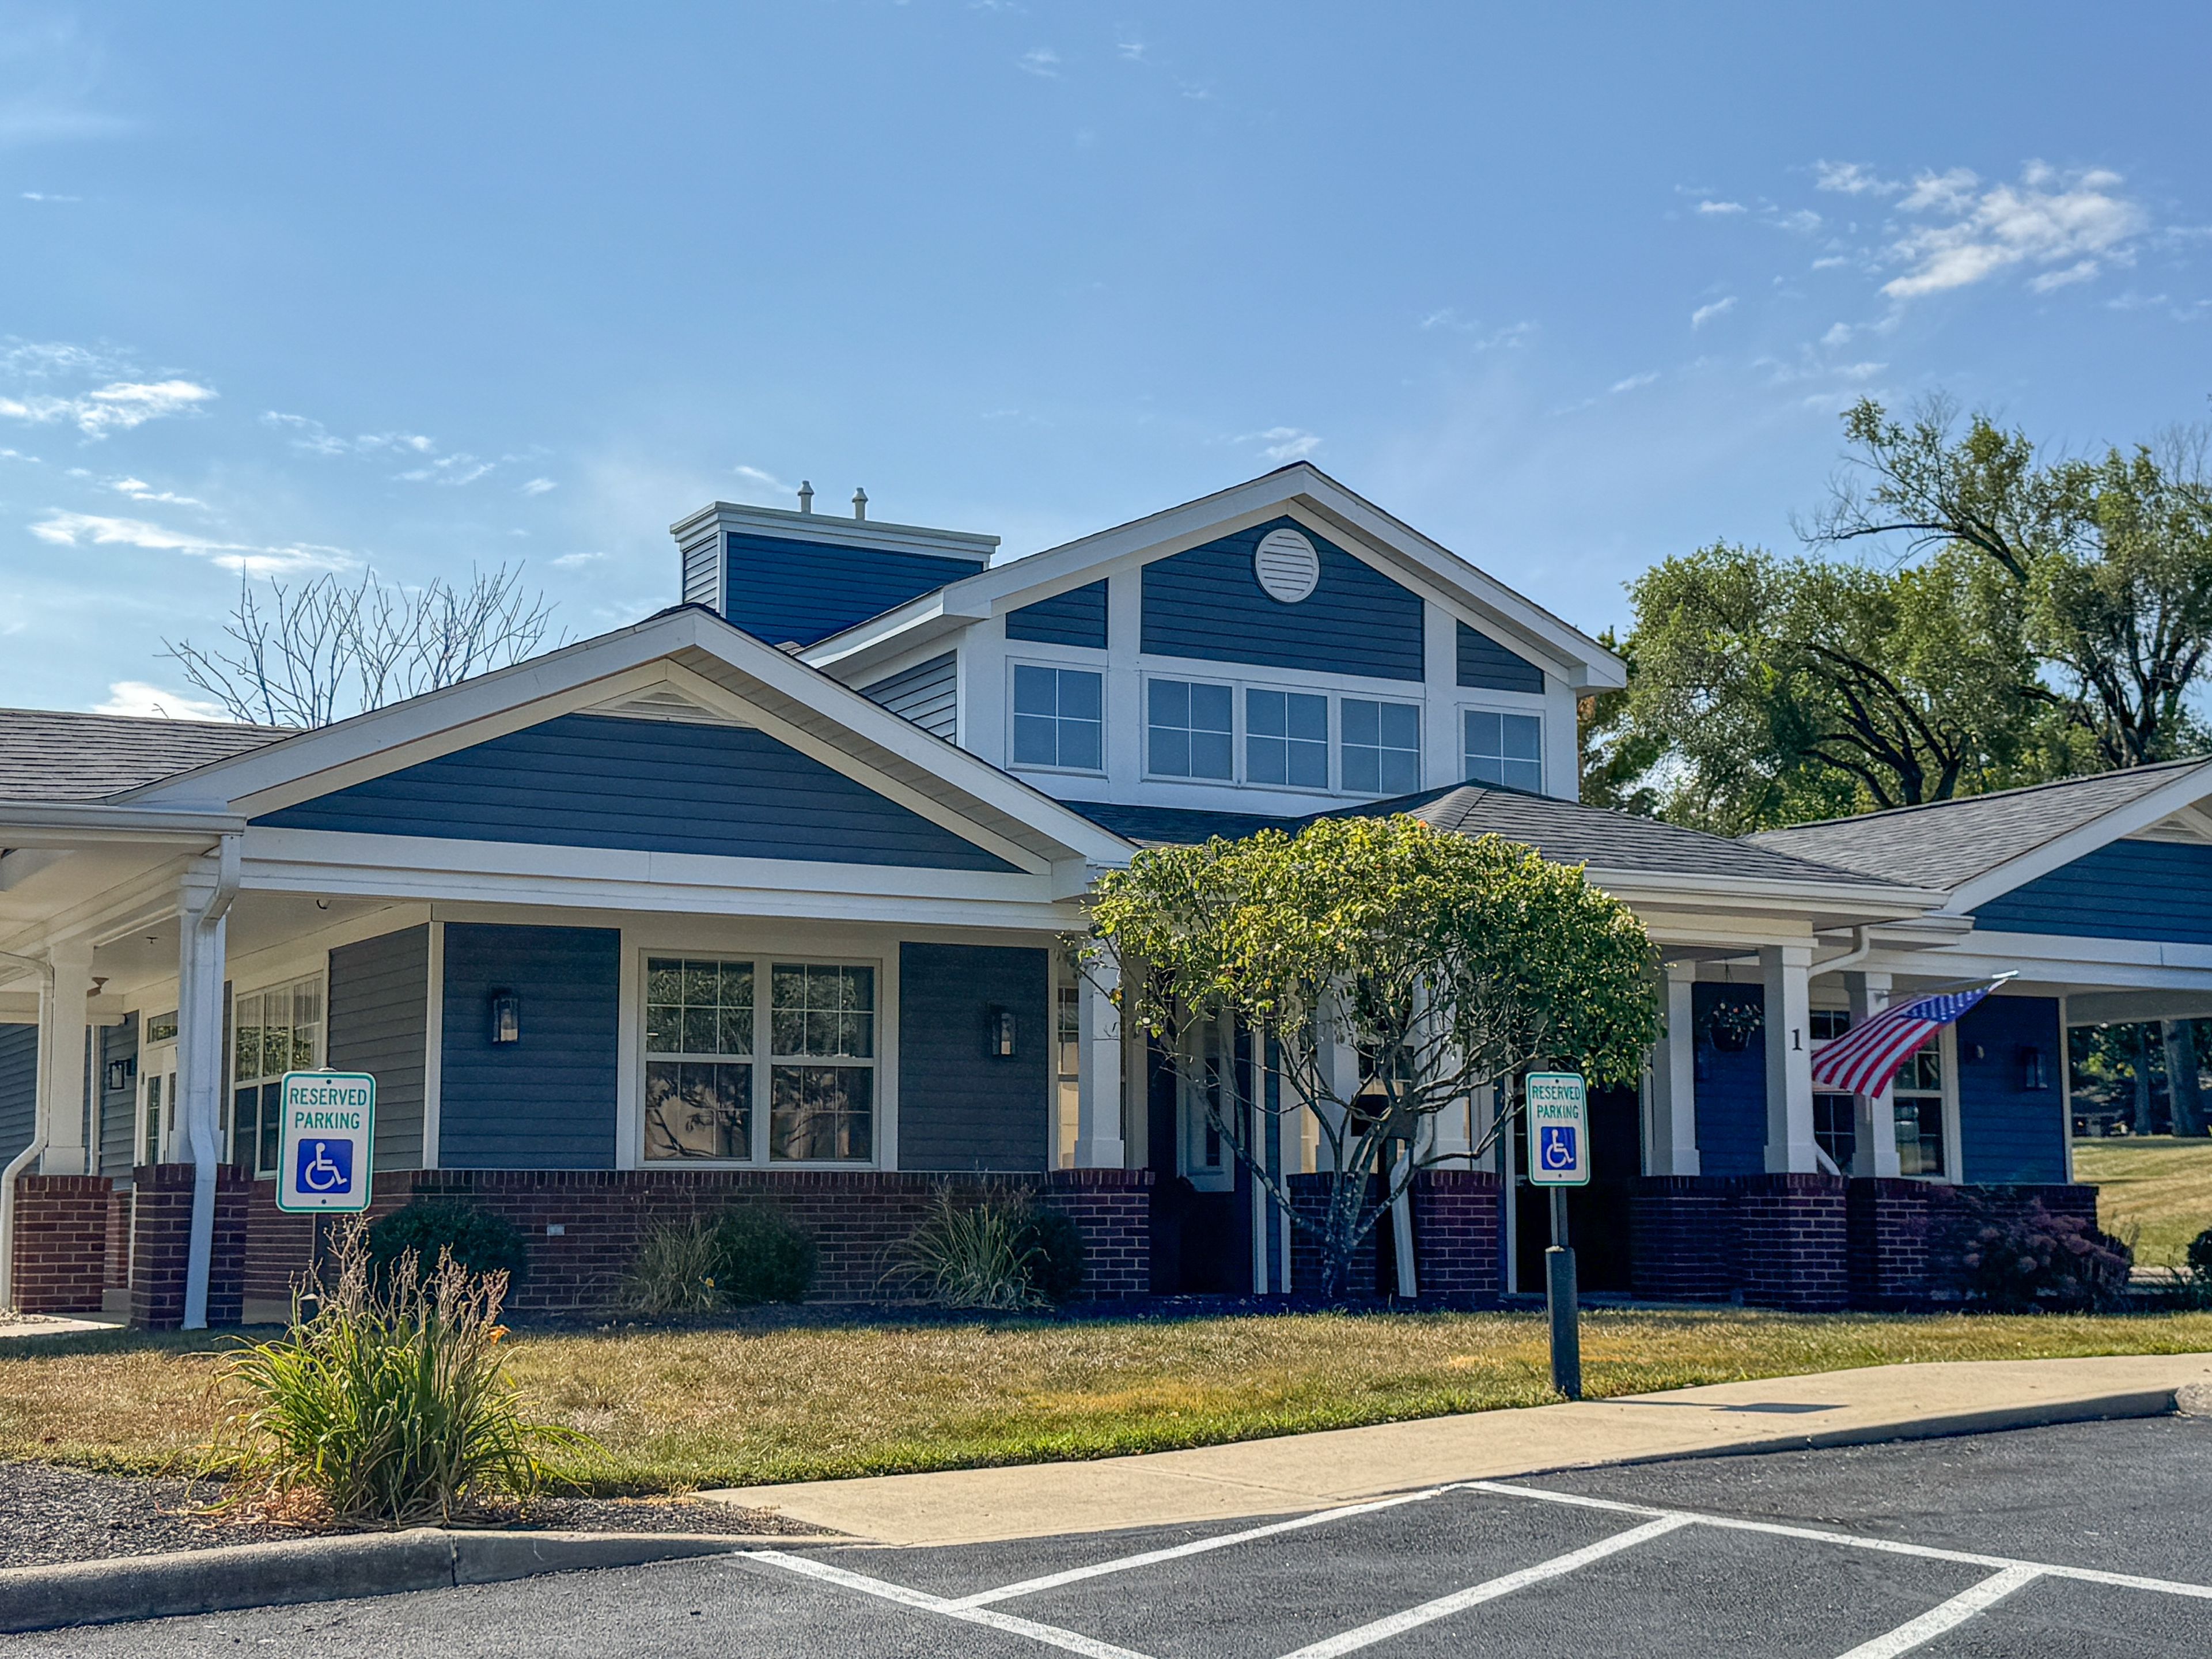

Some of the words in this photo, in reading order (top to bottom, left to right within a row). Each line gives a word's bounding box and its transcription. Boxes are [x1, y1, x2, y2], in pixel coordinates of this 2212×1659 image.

[1791, 1028, 1803, 1051] 1
[290, 1088, 367, 1106] RESERVED
[1532, 1085, 1581, 1100] RESERVED
[1537, 1105, 1578, 1118] PARKING
[295, 1112, 360, 1129] PARKING
